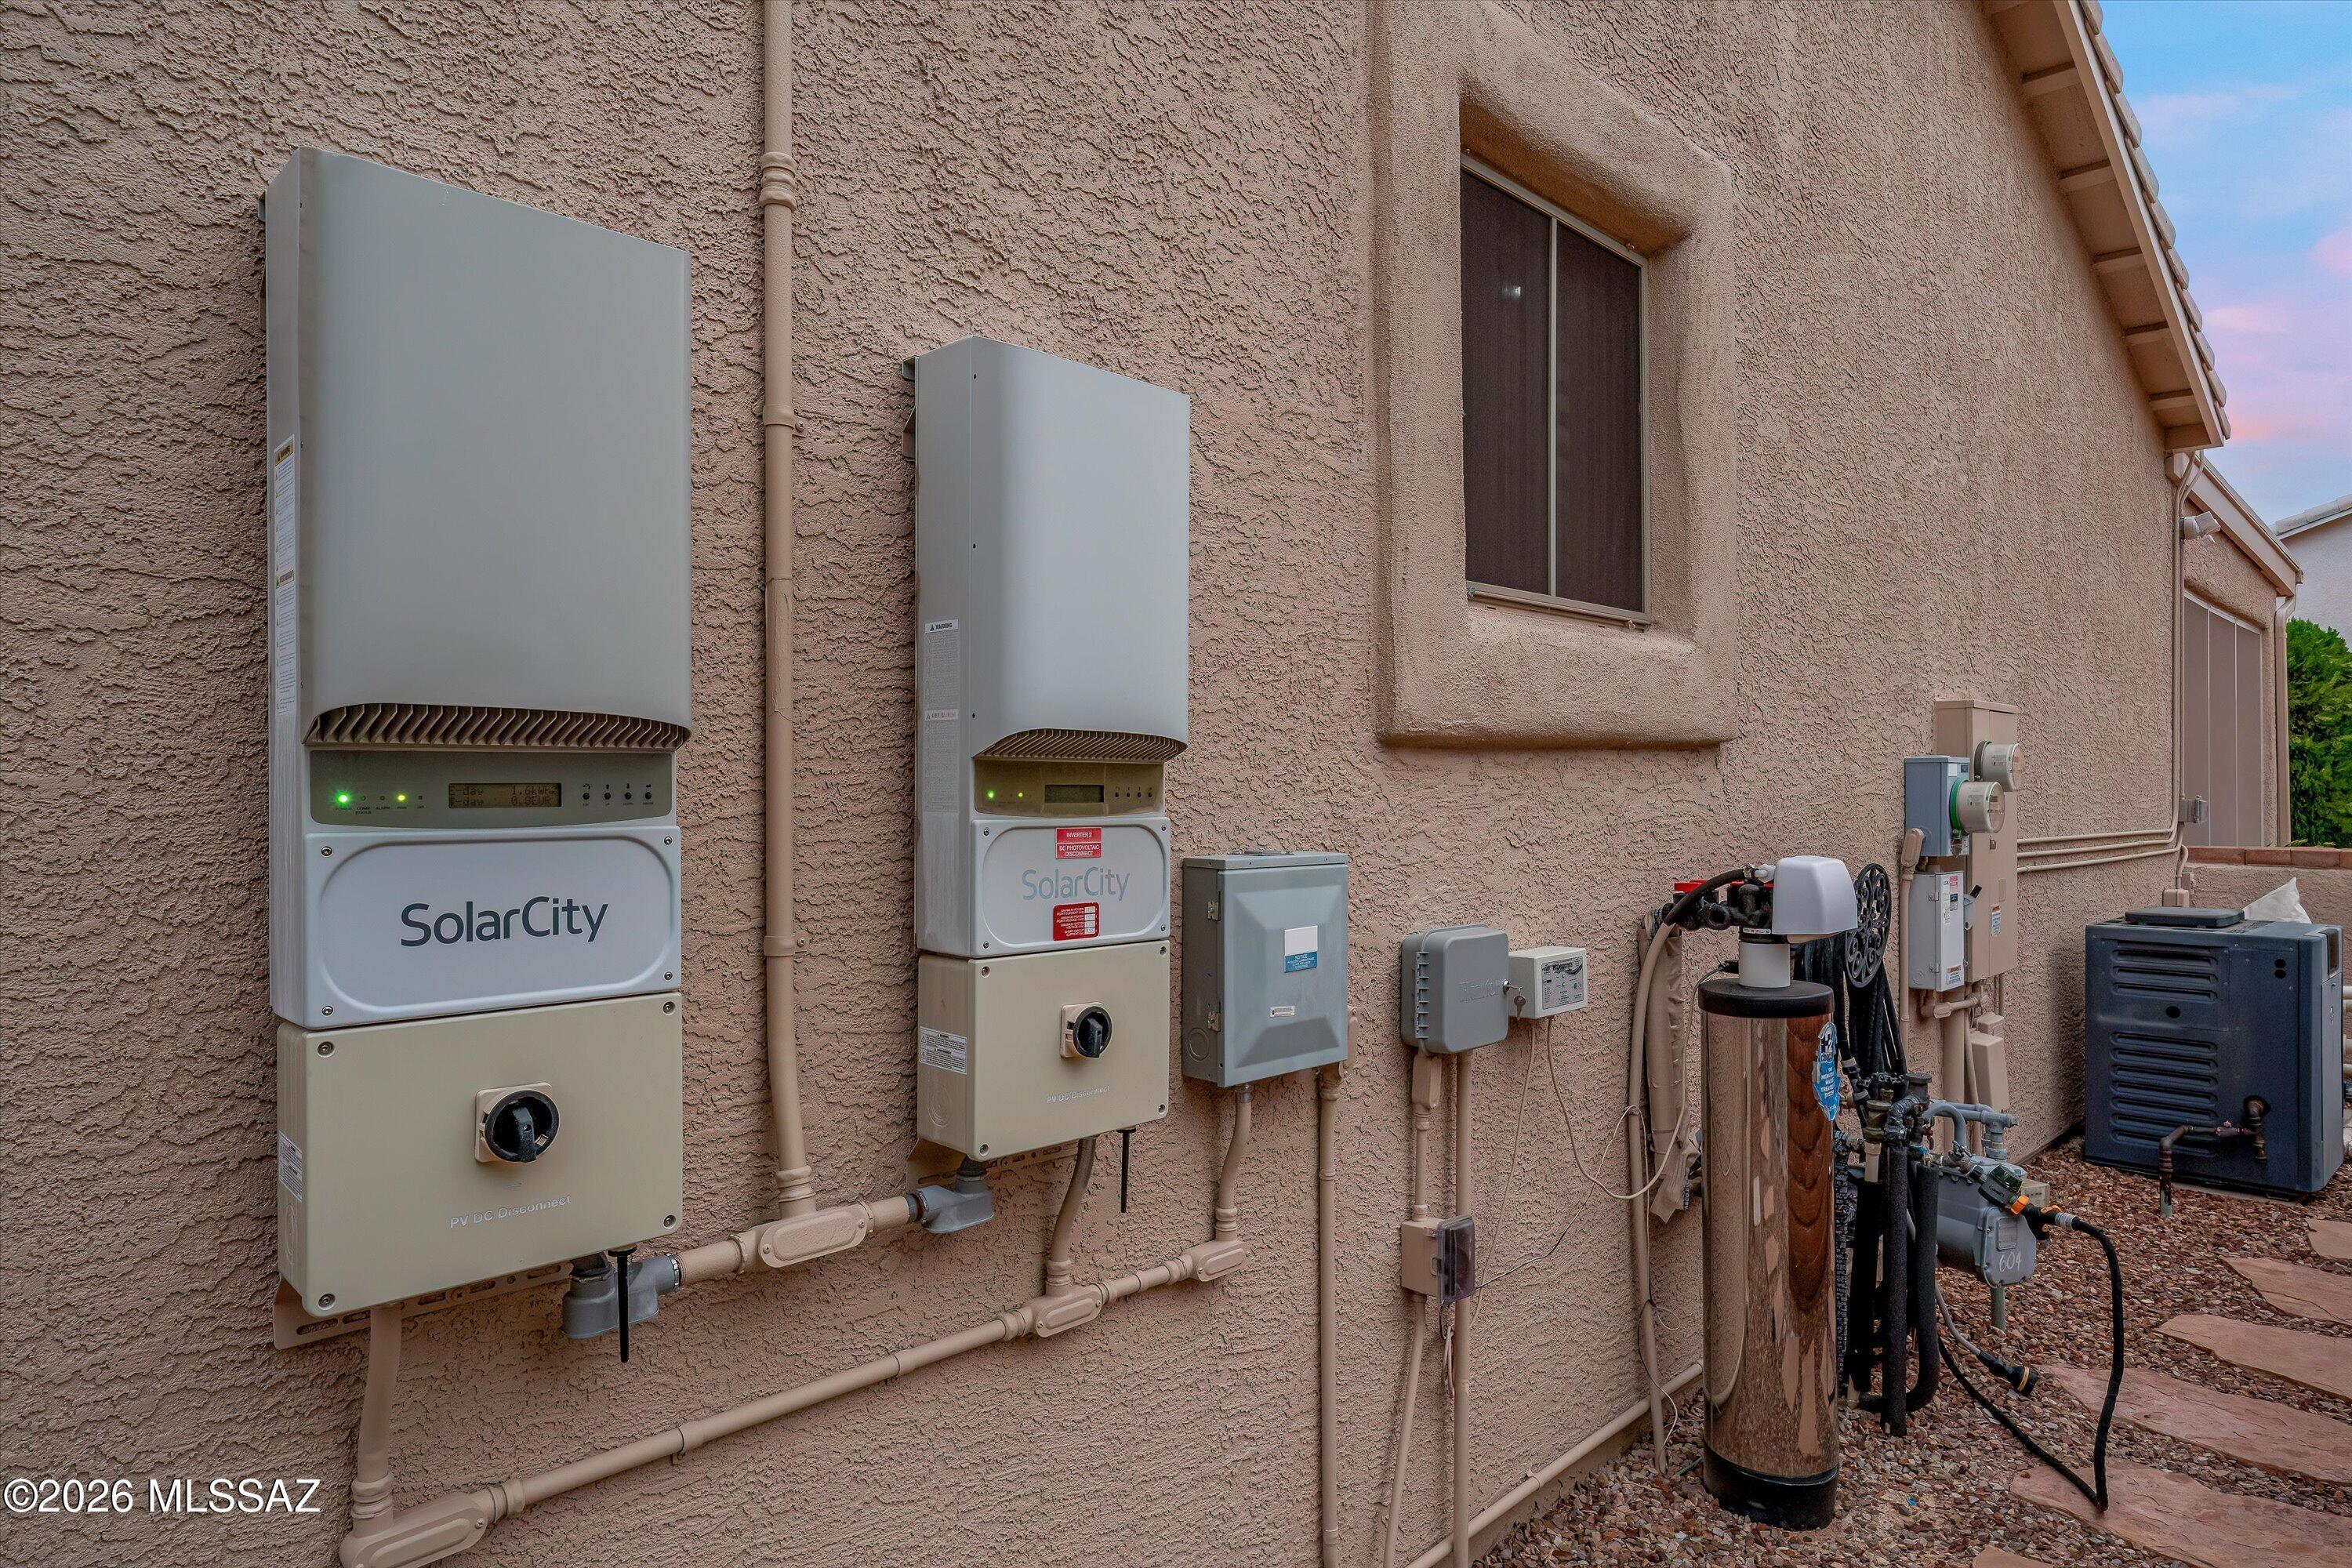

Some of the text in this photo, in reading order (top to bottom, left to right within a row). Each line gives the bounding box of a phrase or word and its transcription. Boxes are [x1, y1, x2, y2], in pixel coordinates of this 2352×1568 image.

[1022, 866, 1131, 902] SolarCity
[401, 895, 609, 947] SolarCity
[1047, 1094, 1057, 1104] PV
[1071, 1085, 1111, 1099] Disconnect
[450, 1194, 572, 1229] PV DC Disconnect
[1998, 1251, 2022, 1272] 604
